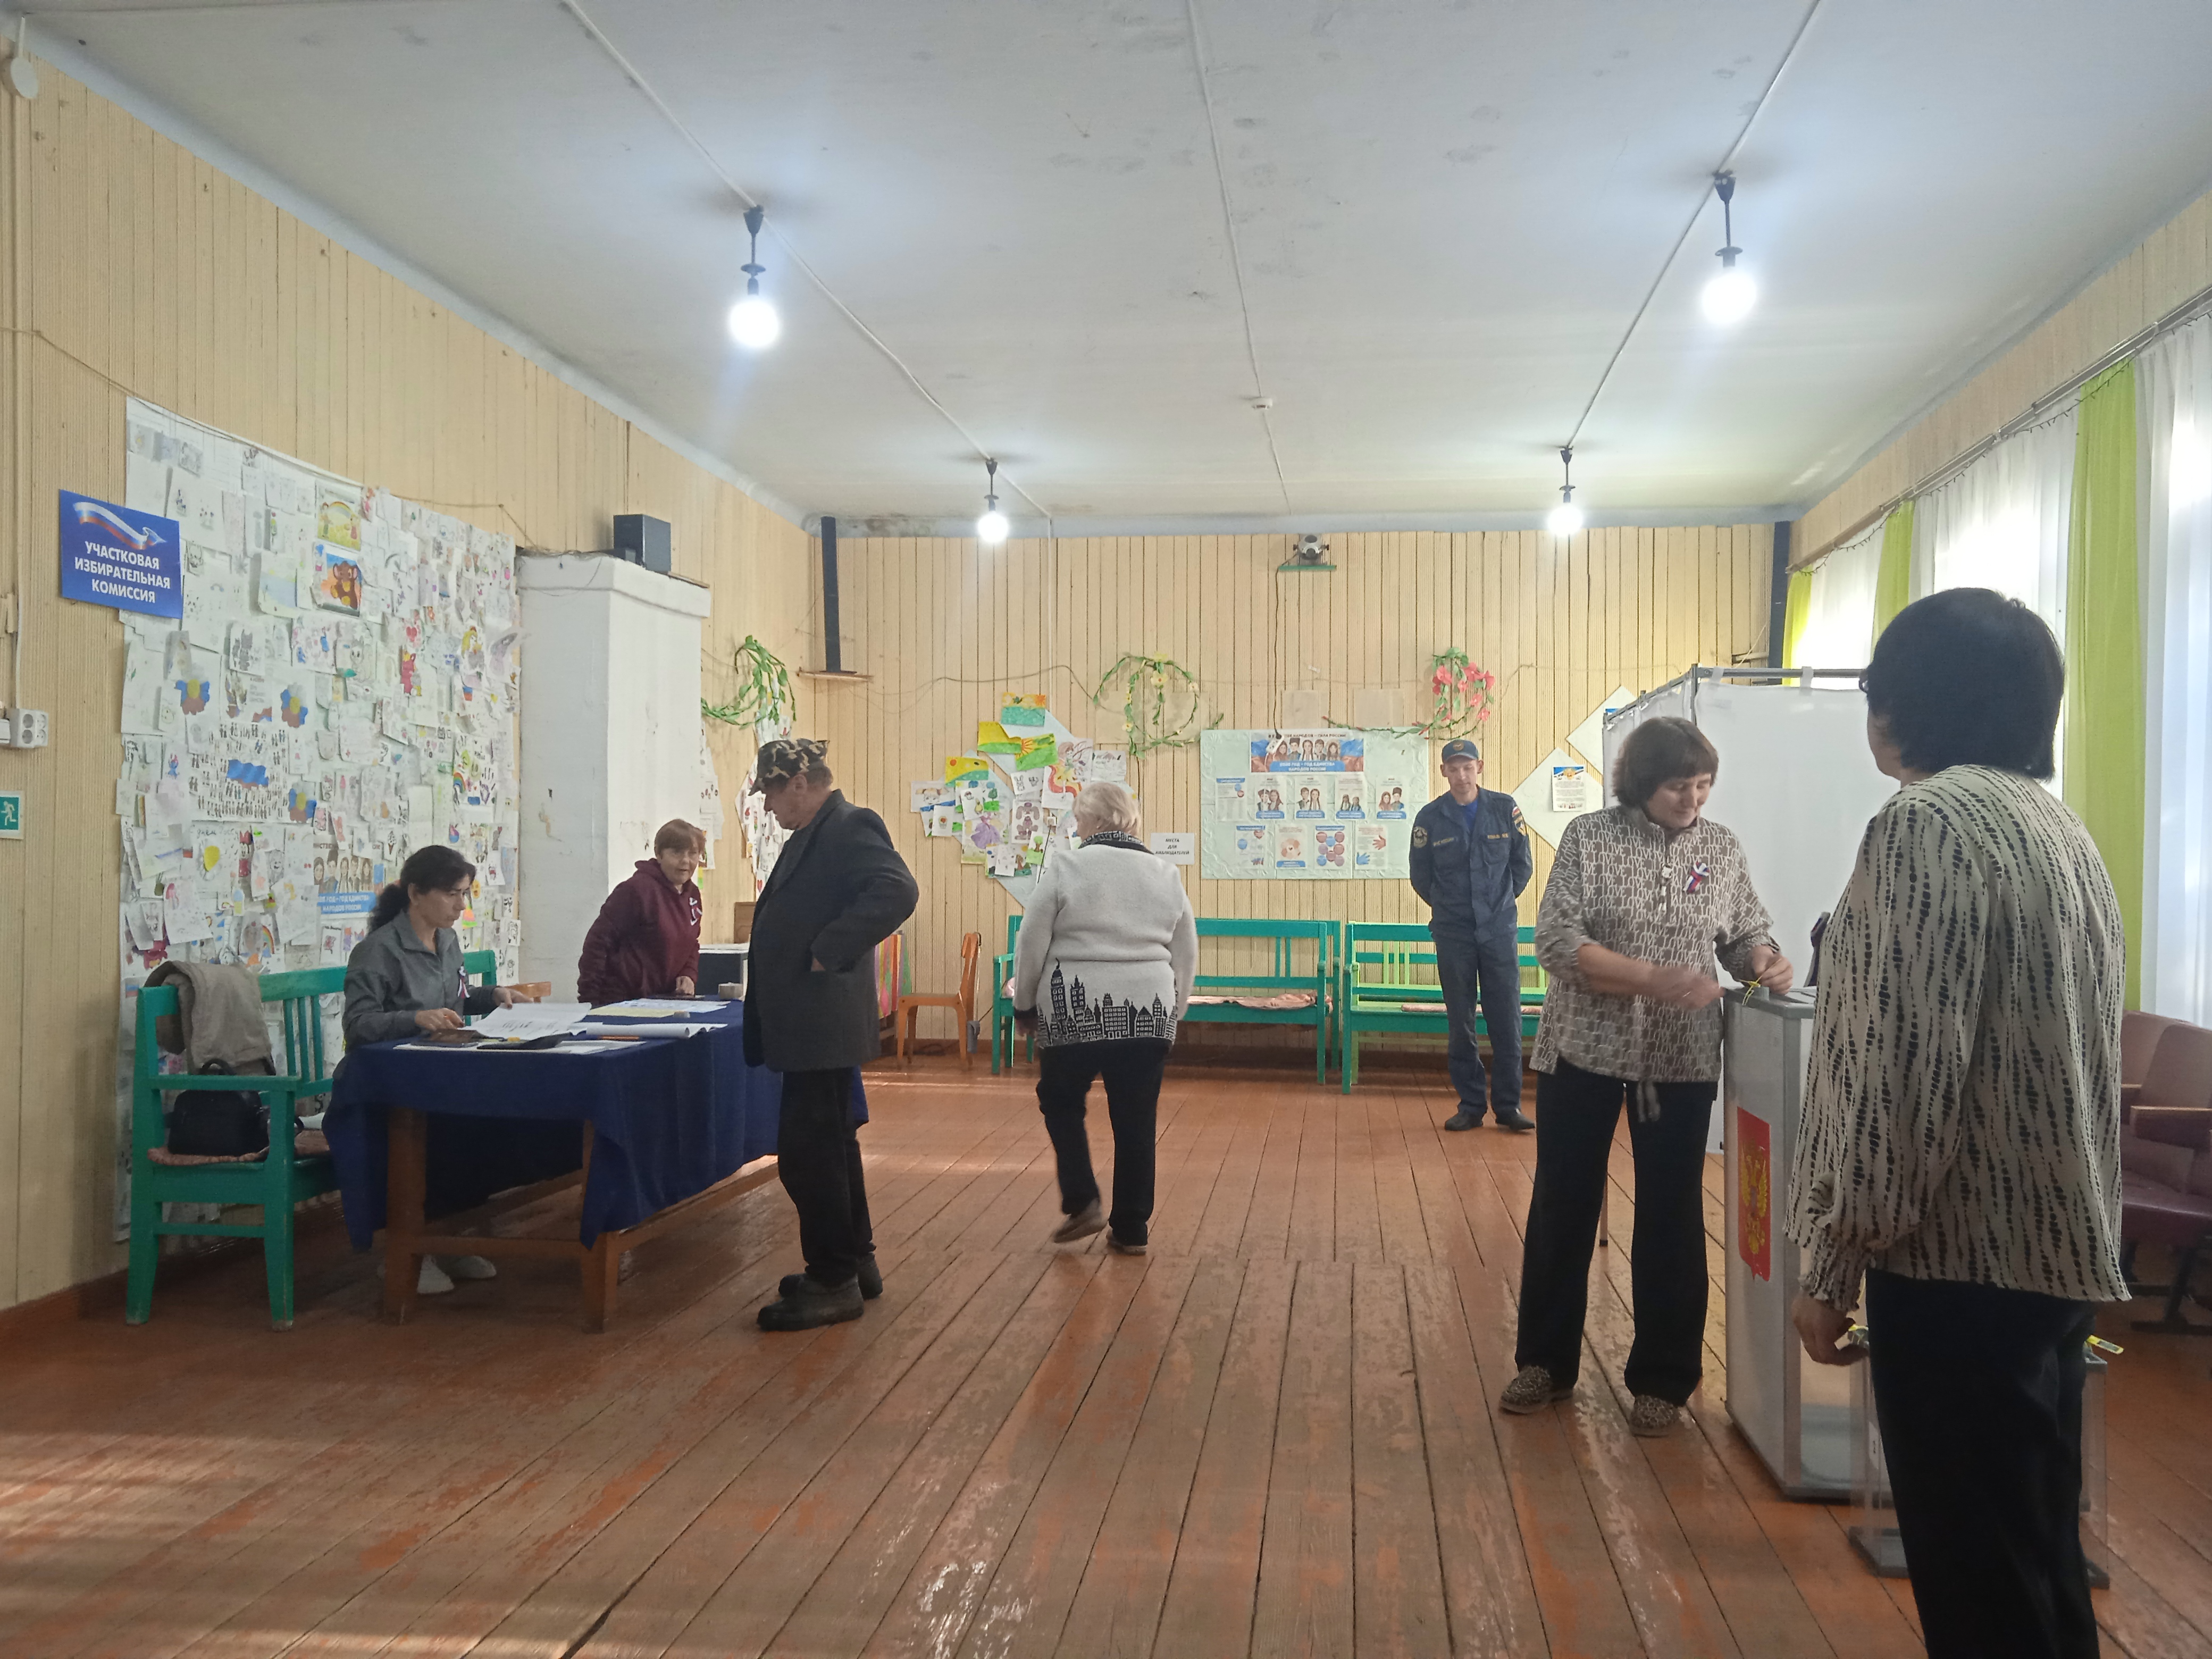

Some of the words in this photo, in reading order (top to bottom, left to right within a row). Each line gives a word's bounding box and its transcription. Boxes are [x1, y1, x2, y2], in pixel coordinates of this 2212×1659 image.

[85, 541, 159, 570] УЧАСТКОВАЯ
[74, 557, 170, 589] ИЗБИРАТЕЛЬНАЯ
[92, 579, 155, 603] КОМИССИЯ
